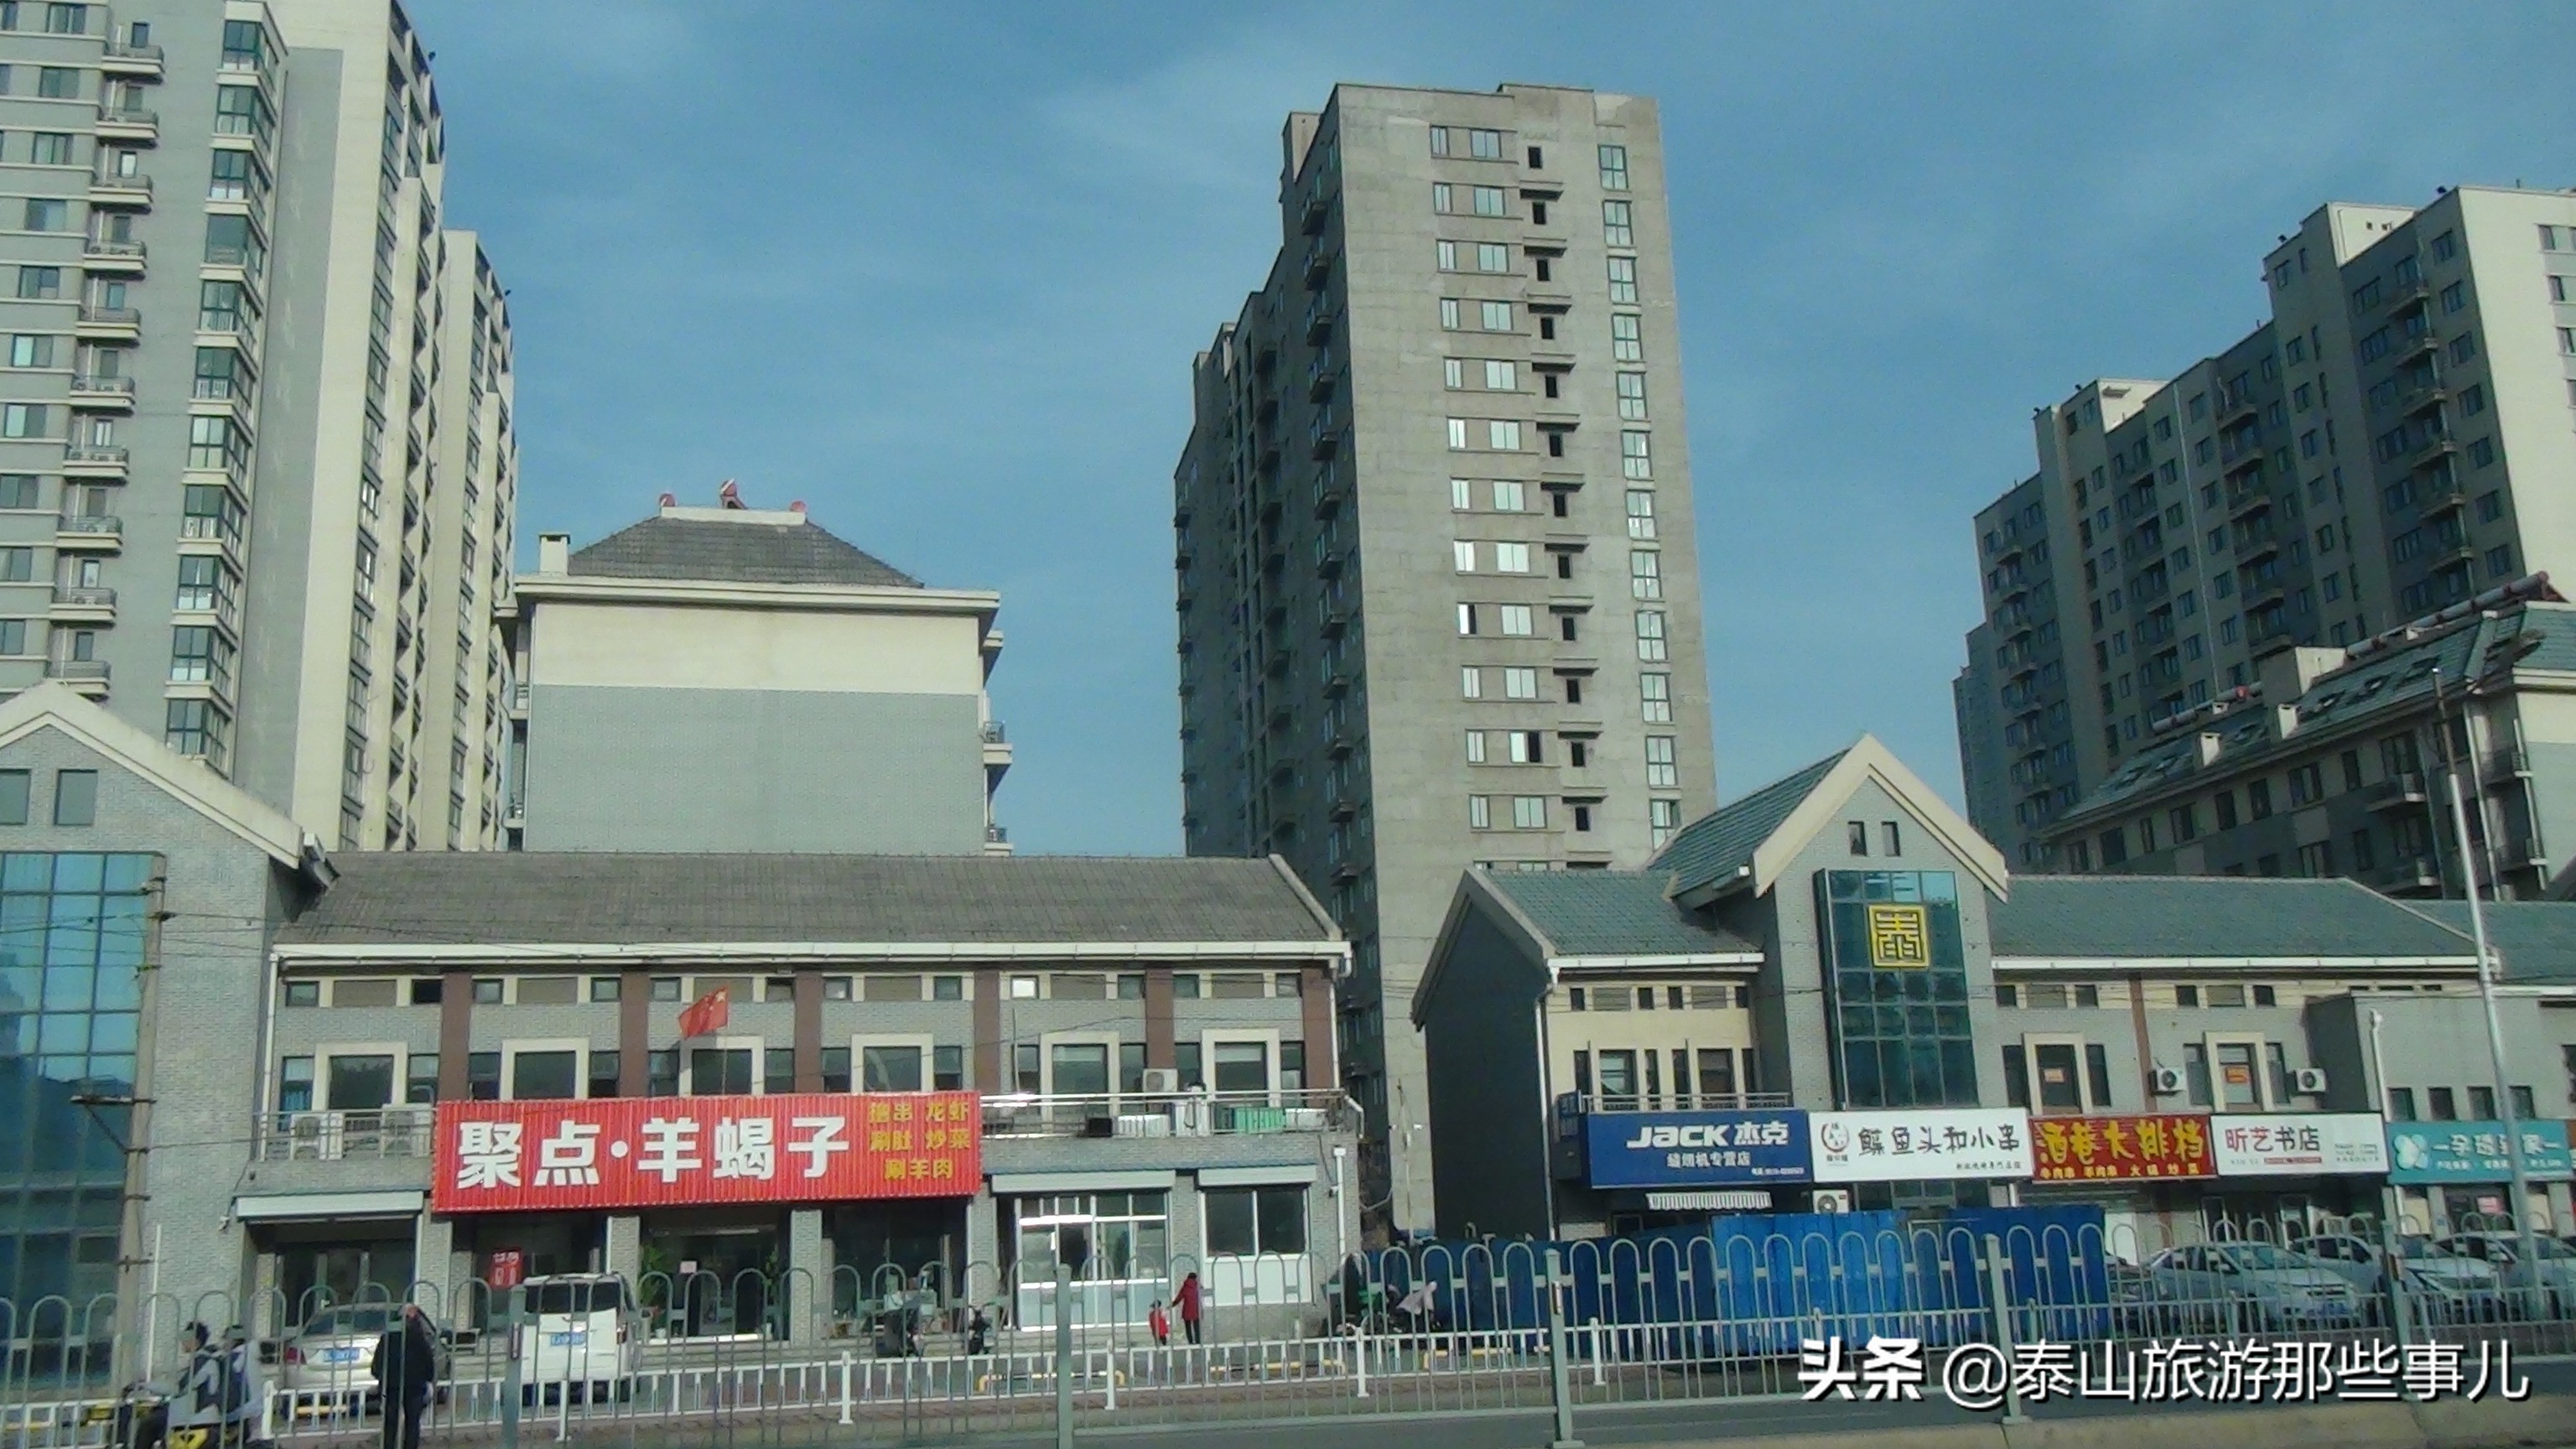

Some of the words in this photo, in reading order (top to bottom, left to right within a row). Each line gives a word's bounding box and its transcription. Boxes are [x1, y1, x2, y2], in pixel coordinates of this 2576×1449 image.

[925, 1101, 969, 1122] 龙虾
[925, 1128, 970, 1150] 炒菜
[1734, 1120, 1789, 1146] 杰克
[2225, 1124, 2321, 1153] 昕艺书店
